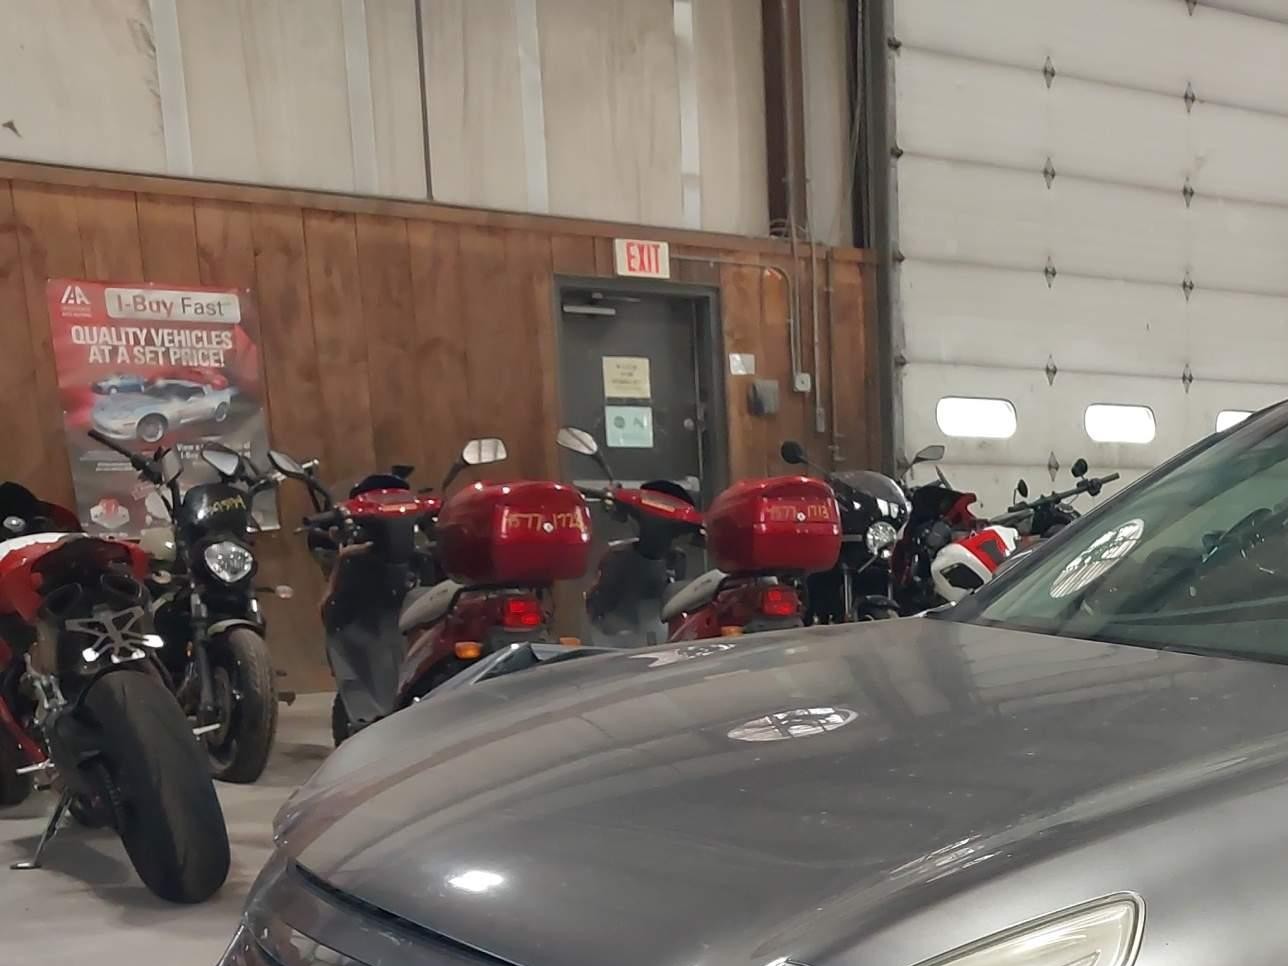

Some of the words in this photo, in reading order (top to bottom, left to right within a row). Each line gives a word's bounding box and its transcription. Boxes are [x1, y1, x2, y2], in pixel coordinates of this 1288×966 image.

[626, 242, 660, 273] EXIT
[117, 293, 174, 317] I-Buy
[181, 297, 224, 316] Fast
[71, 325, 149, 346] QUALITY
[150, 328, 232, 349] VEHICLES
[89, 346, 112, 364] AT
[117, 347, 131, 364] A
[133, 347, 165, 366] SET
[170, 349, 225, 368] PRICE!
